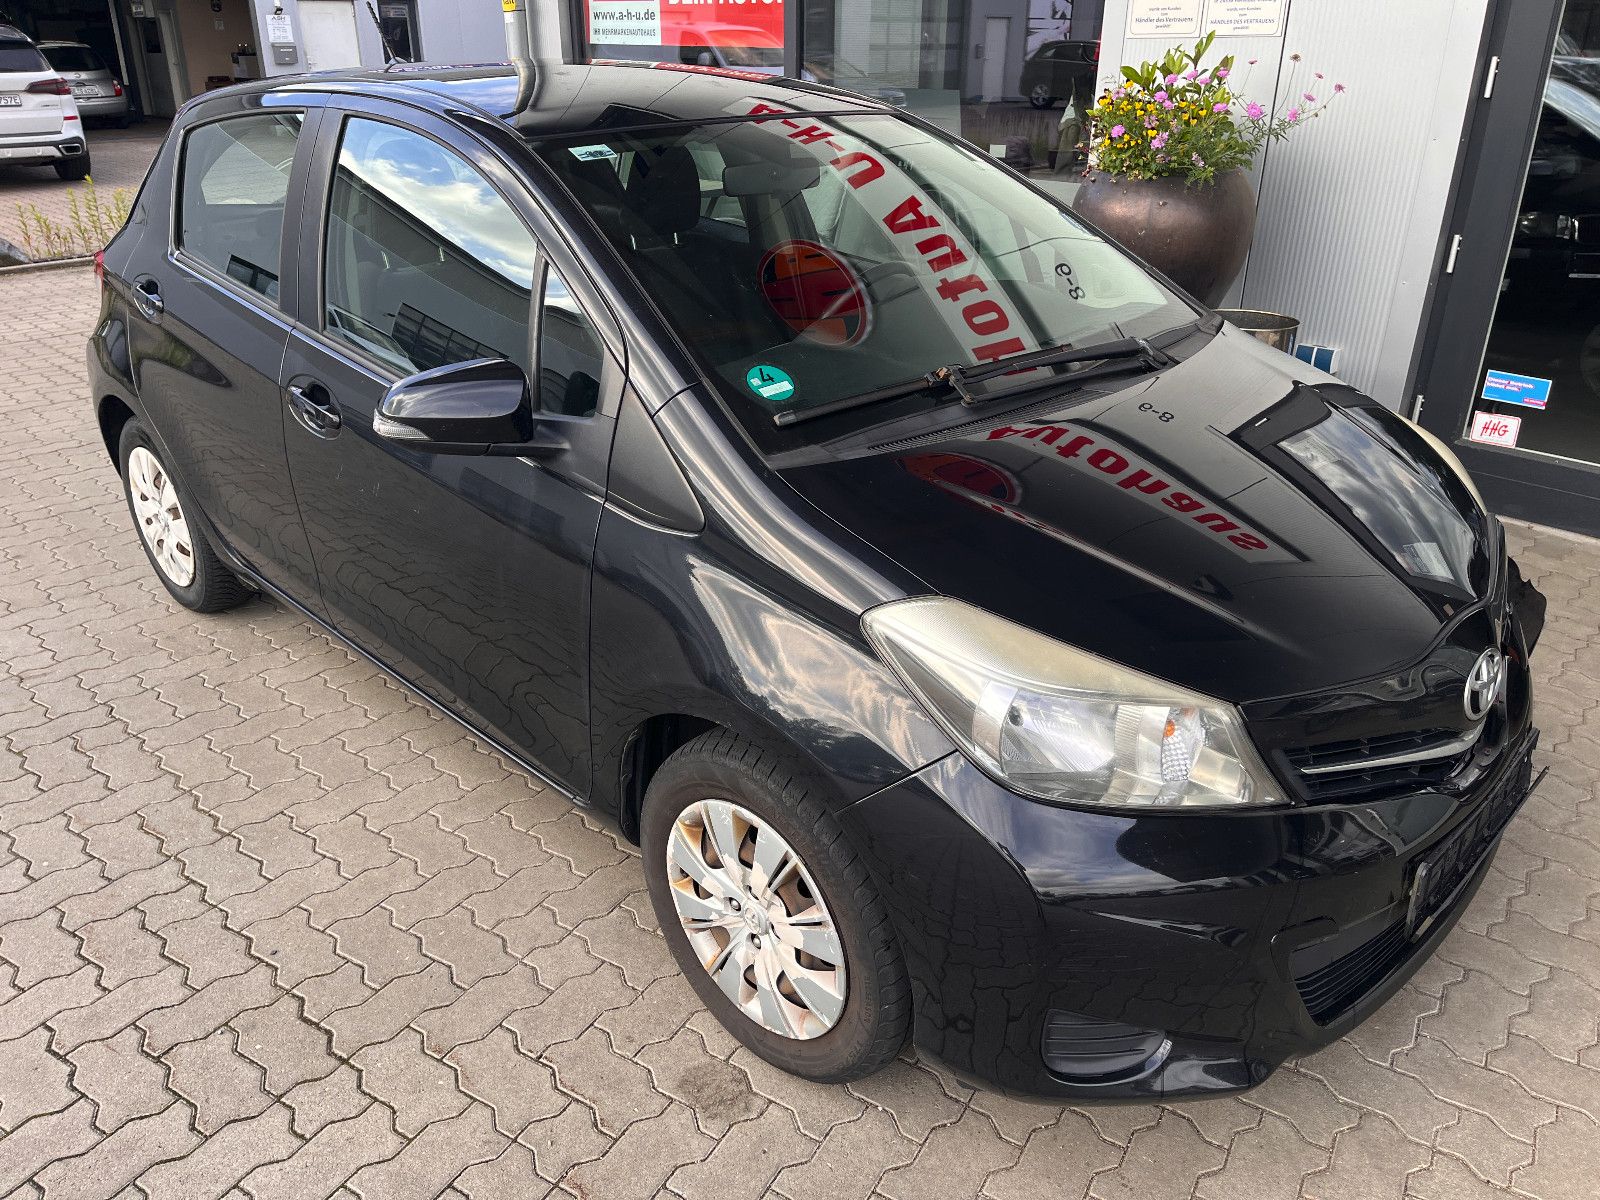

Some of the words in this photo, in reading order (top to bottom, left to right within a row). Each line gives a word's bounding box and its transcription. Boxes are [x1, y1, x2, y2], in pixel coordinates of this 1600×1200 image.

[593, 8, 656, 21] www.a-h-u.de
[759, 367, 775, 383] 4
[1480, 419, 1509, 437] HHG
